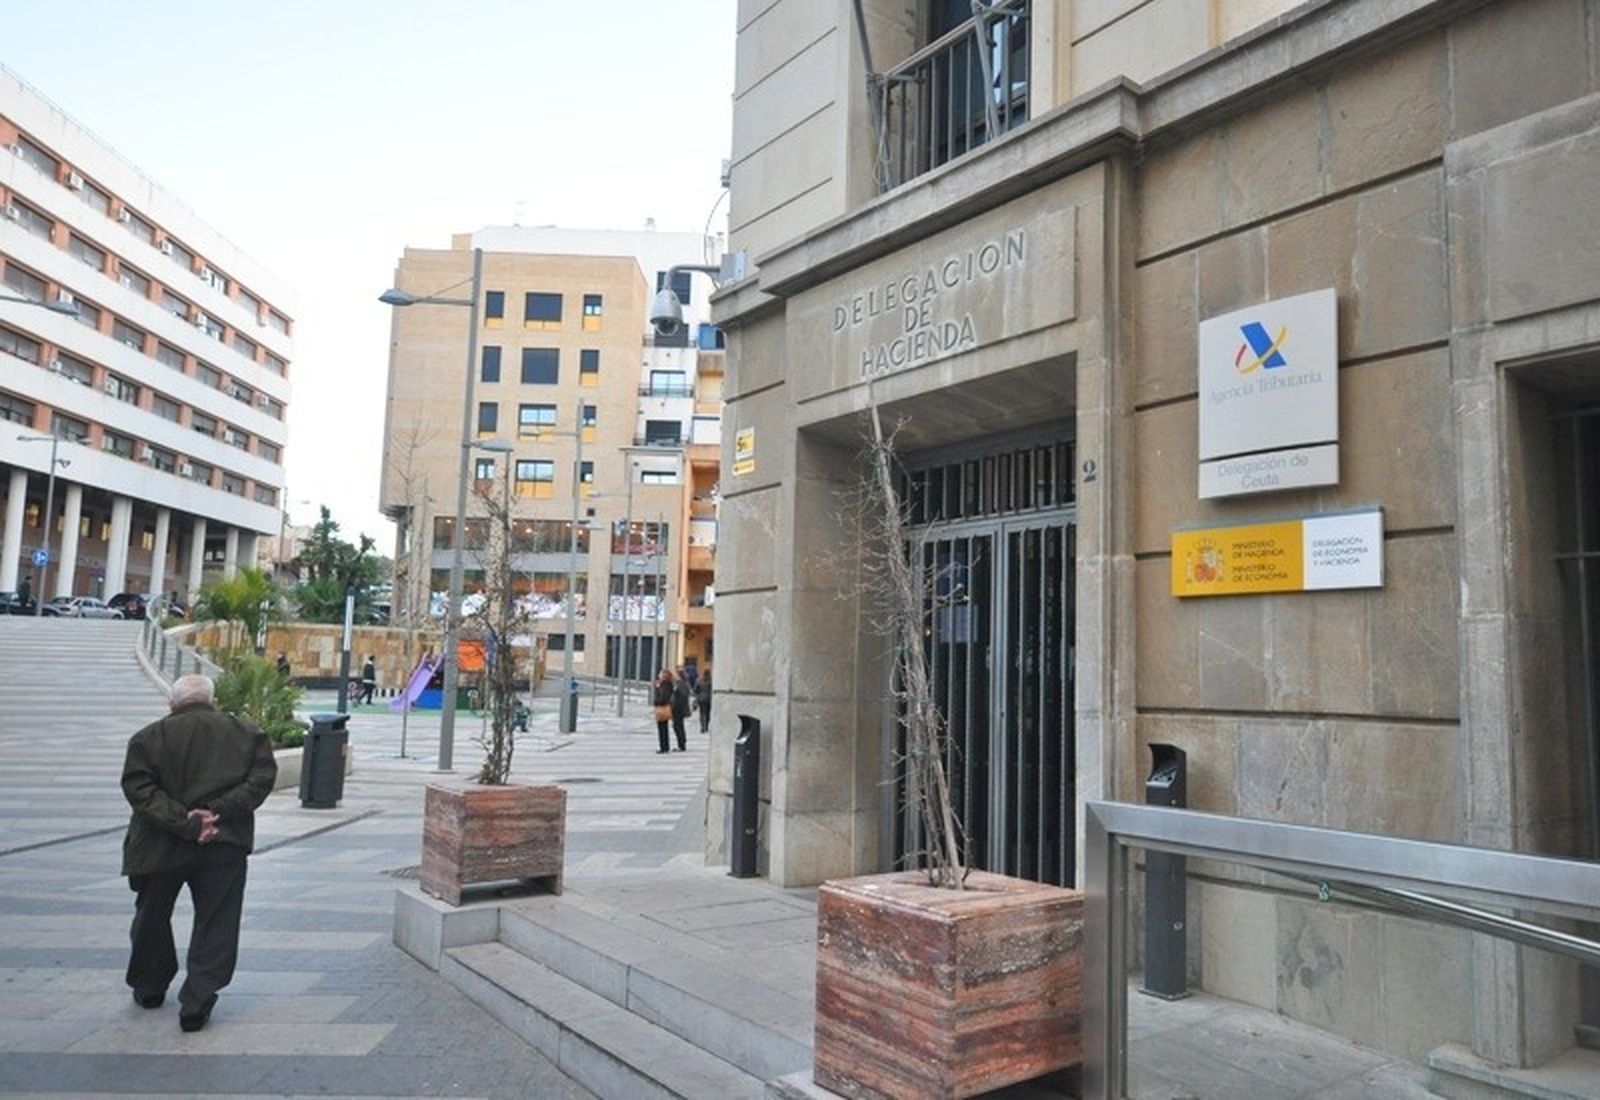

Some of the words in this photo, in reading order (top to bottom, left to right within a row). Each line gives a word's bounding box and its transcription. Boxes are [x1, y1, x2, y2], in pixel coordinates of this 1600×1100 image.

[833, 230, 1026, 332] DELEGACION
[904, 298, 931, 333] DE
[860, 314, 976, 377] HACIENDA
[1256, 371, 1323, 392] Tributaria
[1083, 460, 1097, 483] 2
[1290, 453, 1309, 467] de
[1241, 474, 1280, 489] Ceuta
